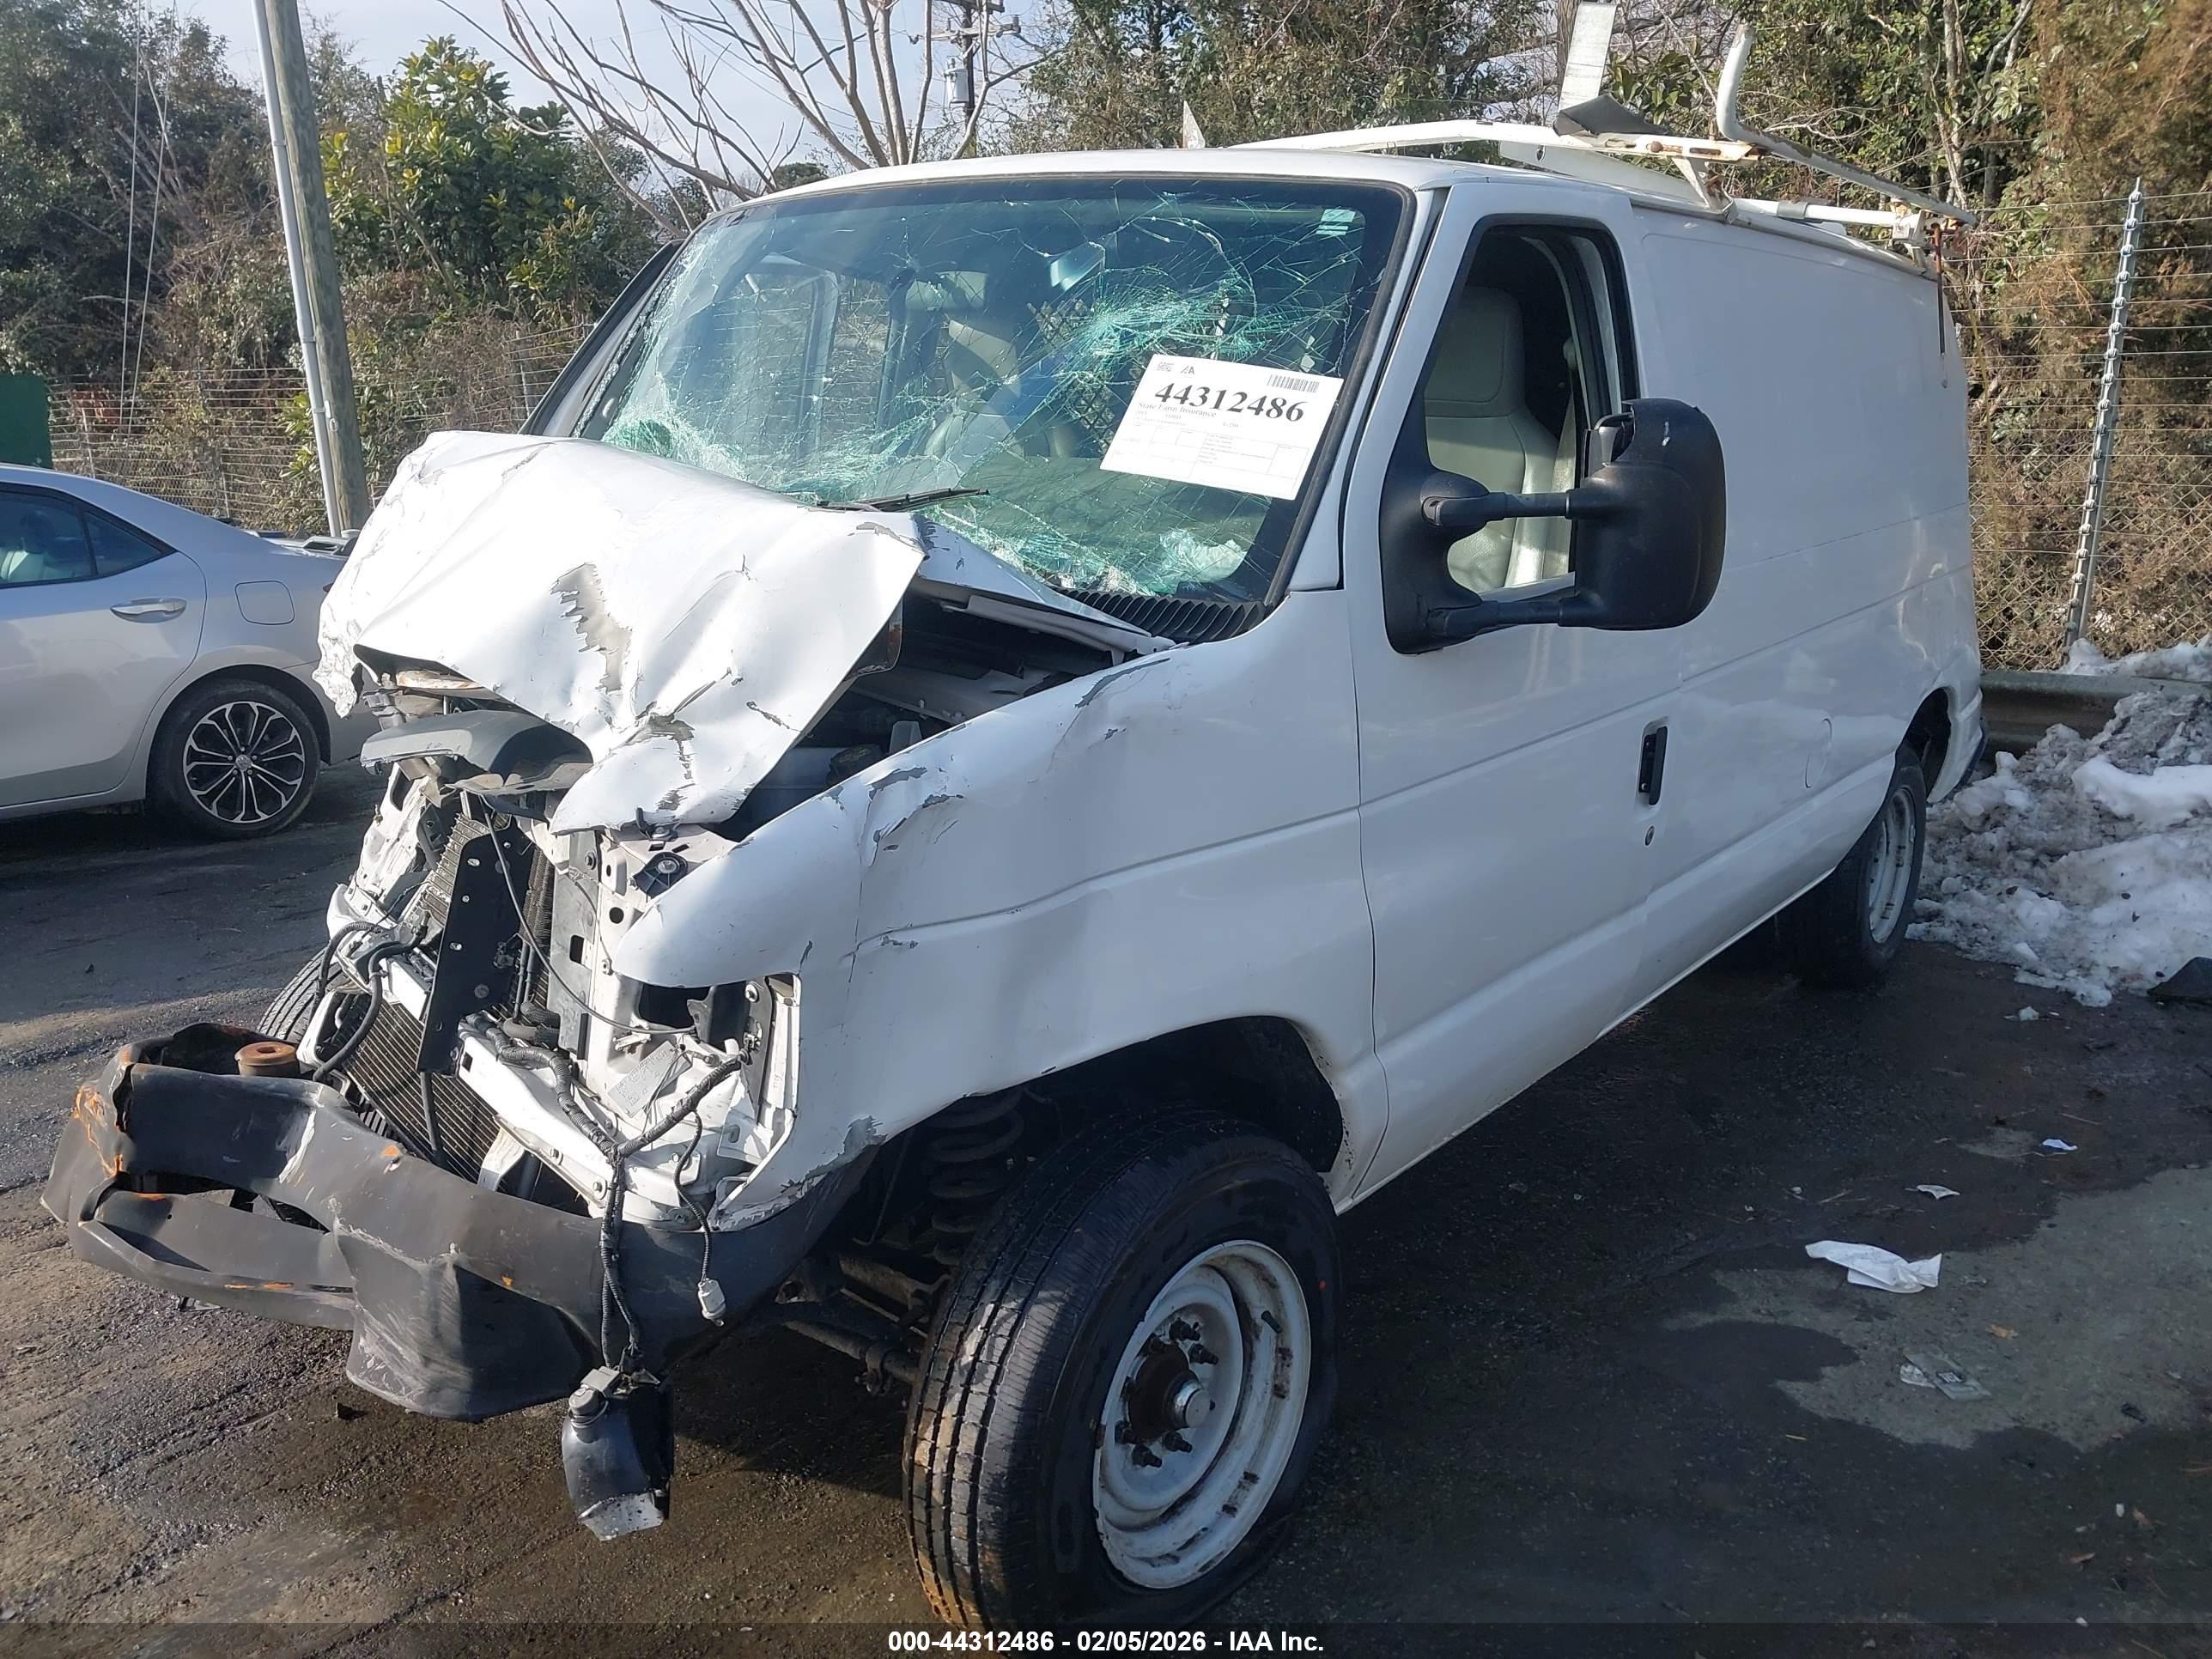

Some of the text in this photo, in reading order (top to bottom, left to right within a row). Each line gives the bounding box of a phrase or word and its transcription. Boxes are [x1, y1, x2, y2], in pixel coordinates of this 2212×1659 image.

[1138, 401, 1156, 410] State
[1180, 405, 1217, 418] Insurance
[1154, 382, 1309, 422] 44312486
